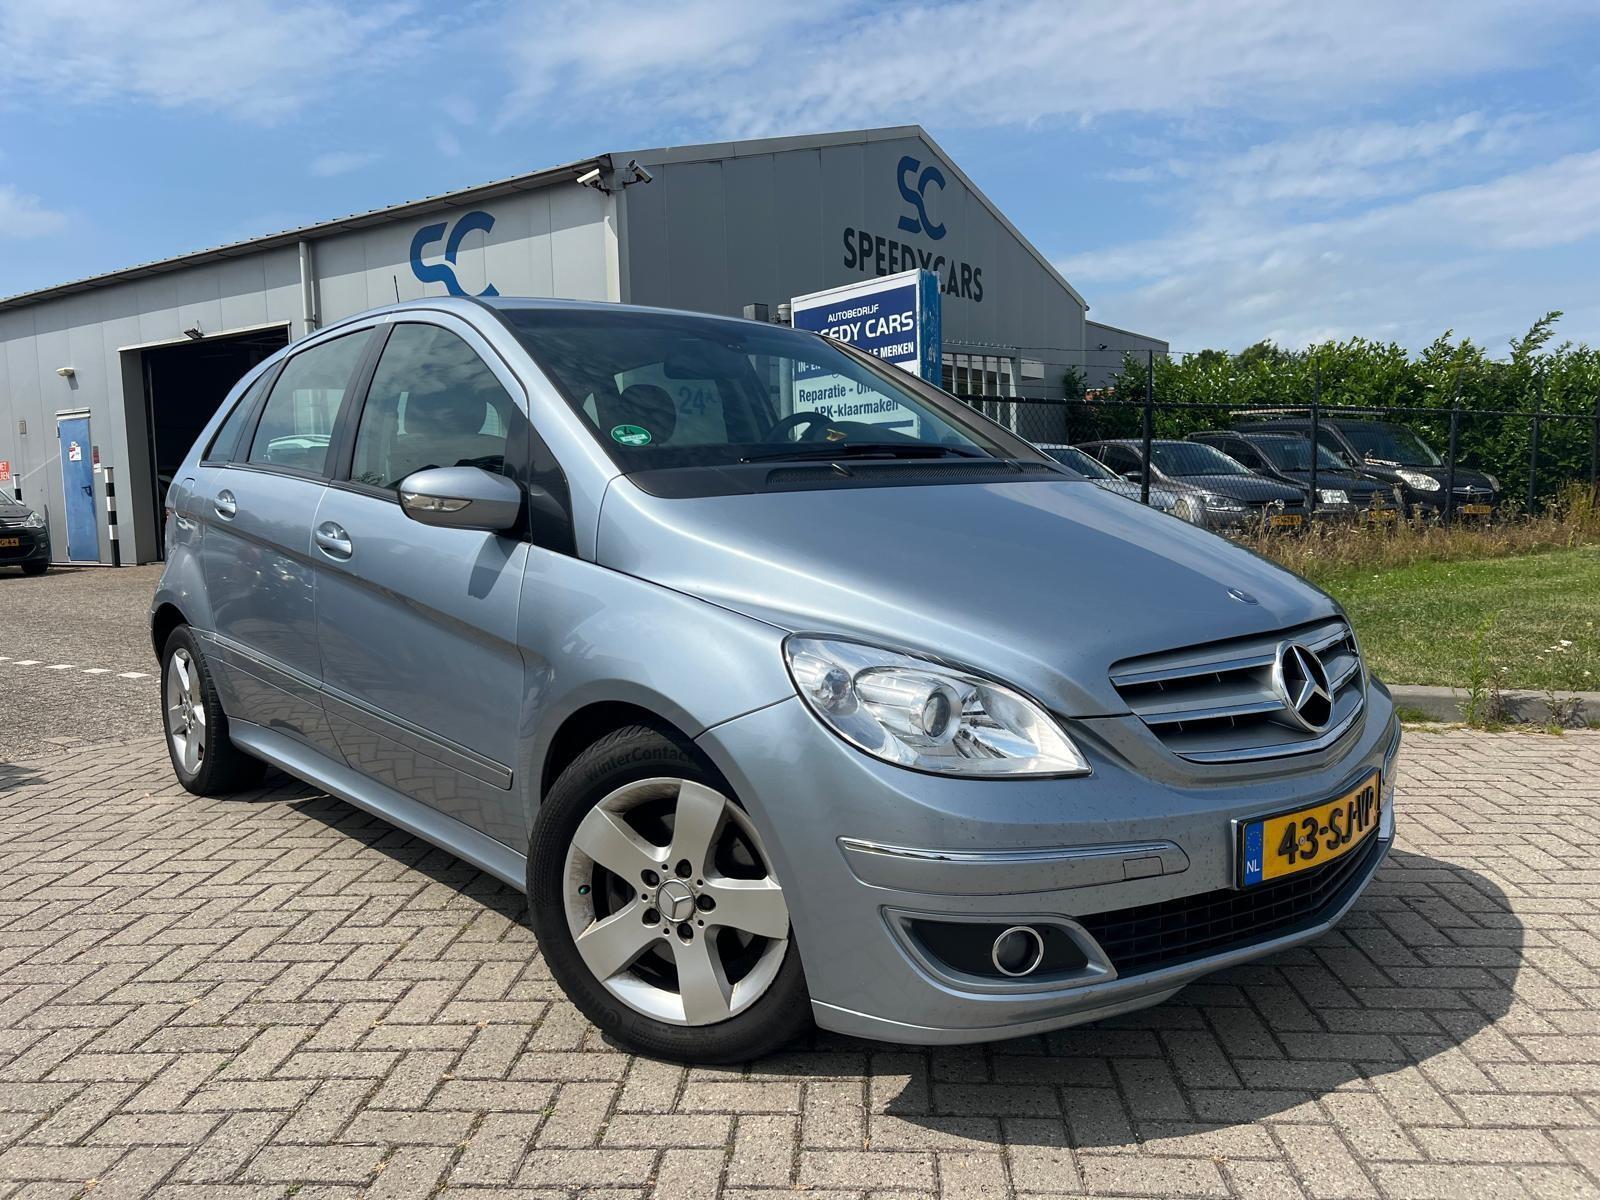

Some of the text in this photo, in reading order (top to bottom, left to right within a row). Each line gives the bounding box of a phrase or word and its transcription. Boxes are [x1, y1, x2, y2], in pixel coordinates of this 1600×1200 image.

[827, 303, 880, 323] AUTOBEDRIJF
[865, 311, 914, 338] CARS
[880, 341, 914, 359] MERKEN
[799, 384, 846, 404] Reparatie
[1246, 858, 1261, 874] NL
